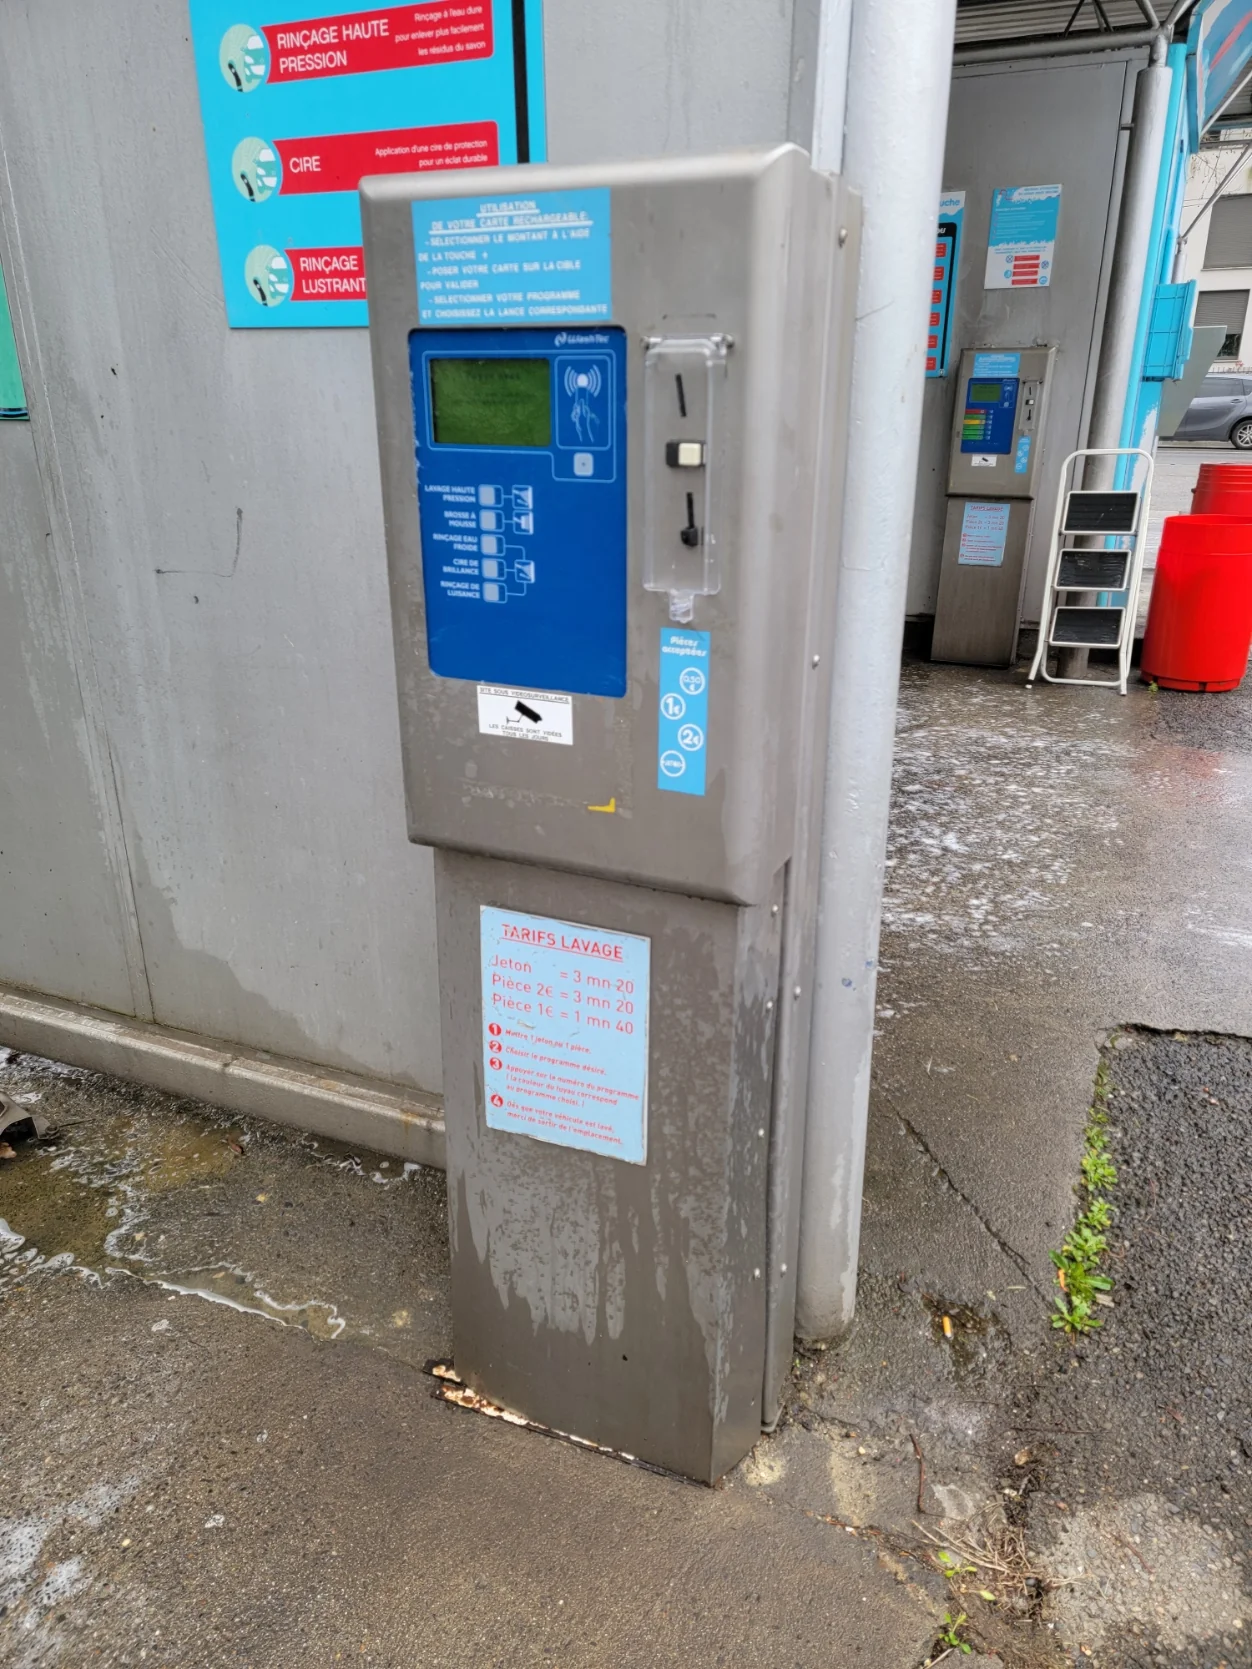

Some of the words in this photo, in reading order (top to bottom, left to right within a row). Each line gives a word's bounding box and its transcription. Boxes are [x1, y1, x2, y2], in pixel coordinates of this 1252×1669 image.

[414, 11, 441, 22] Rinçage
[467, 6, 482, 15] dure
[277, 27, 338, 51] RINÇAGE
[343, 19, 389, 39] HAUTE
[395, 34, 409, 43] pour
[411, 30, 433, 39] enlever
[436, 28, 449, 38] plus
[451, 23, 484, 34] facilement
[418, 48, 428, 56] les
[430, 44, 453, 54] résidus
[455, 43, 463, 51] du
[466, 41, 486, 50] savon
[279, 51, 347, 74] PRESSION
[375, 146, 410, 157] Application
[411, 145, 428, 153] d'une
[430, 143, 442, 151] cire
[454, 140, 487, 151] protection
[290, 156, 321, 172] CIRE
[419, 159, 433, 168] pour
[445, 156, 461, 164] éclat
[463, 154, 488, 163] durable
[480, 200, 536, 213] UTILISATION
[432, 221, 443, 230] DE
[447, 219, 475, 229] VOTRE
[480, 216, 509, 228] CARTE
[494, 233, 503, 243] LE
[508, 231, 547, 242] MONTANT
[418, 253, 428, 261] DE
[433, 252, 442, 261] LA
[445, 250, 476, 260] TOUCHE
[300, 255, 358, 272] RINÇAGE
[462, 264, 488, 274] VOTRE
[492, 262, 519, 273] CARTE
[524, 261, 539, 271] SUR
[543, 261, 554, 271] LA
[420, 281, 441, 290] POUR
[445, 280, 479, 289] VALIDER
[497, 292, 523, 302] VOTRE
[527, 290, 580, 300] PROGRAMME
[423, 310, 432, 318] ET
[484, 308, 495, 317] LA
[499, 307, 524, 316] LANCE
[425, 485, 450, 493] LAVAGE
[451, 486, 475, 494] HAUTE
[443, 494, 475, 503] PRESSION
[444, 511, 469, 519] BROSSE
[449, 520, 476, 528] MOUSSE
[433, 533, 461, 542] RINÇAGE
[453, 543, 478, 551] FROIDE
[443, 566, 479, 575] BRILLANCE
[440, 580, 469, 589] RINÇAGE
[501, 924, 556, 946] TARIFS
[561, 936, 623, 960] LAVAGE
[492, 955, 532, 973] Jeton
[573, 971, 581, 983] 3
[587, 975, 610, 989] mn
[616, 979, 634, 994] 20
[492, 973, 531, 992] Pièce
[537, 983, 553, 998] 2€
[573, 991, 581, 1003] 3
[587, 996, 610, 1010] mn
[616, 1000, 634, 1014] 20
[493, 993, 531, 1012] Pièce
[538, 1003, 553, 1018] 1€
[575, 1011, 580, 1022] 1
[587, 1016, 610, 1029] mn
[616, 1019, 633, 1034] 40
[506, 1047, 529, 1057] Choisir
[539, 1055, 580, 1069] programme
[506, 1064, 534, 1076] Appuyer
[536, 1071, 546, 1079] sur
[558, 1076, 584, 1087] numéro
[586, 1081, 595, 1090] du
[597, 1085, 639, 1100] programme
[516, 1086, 556, 1101] programme
[518, 1076, 544, 1088] couleur
[556, 1085, 575, 1096] tuyau
[577, 1089, 617, 1105] correspond
[507, 1100, 519, 1109] Dès
[521, 1105, 533, 1113] que
[535, 1107, 552, 1116] votre
[555, 1111, 583, 1125] véhicule
[585, 1119, 596, 1127] est
[507, 1111, 526, 1121] merci
[528, 1114, 536, 1122] de
[538, 1117, 556, 1128] sortir
[559, 1122, 567, 1130] de
